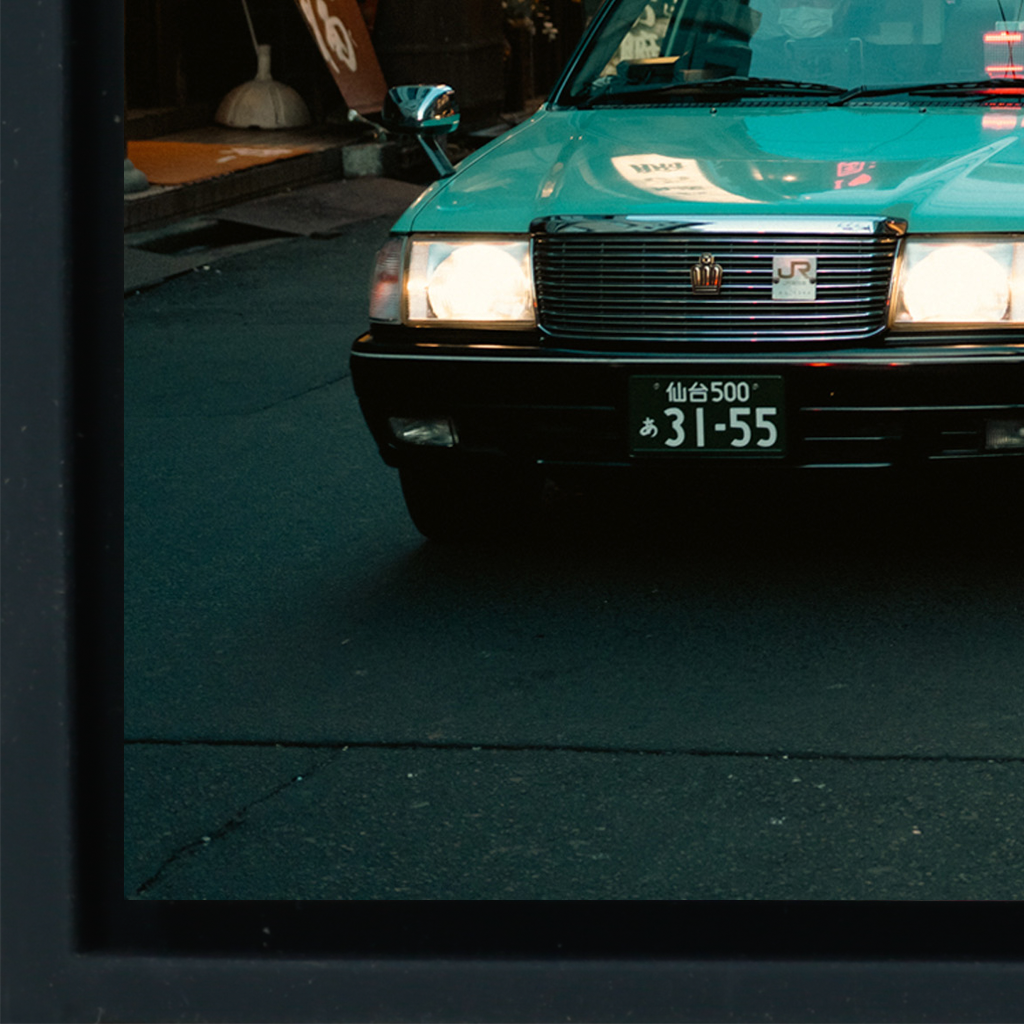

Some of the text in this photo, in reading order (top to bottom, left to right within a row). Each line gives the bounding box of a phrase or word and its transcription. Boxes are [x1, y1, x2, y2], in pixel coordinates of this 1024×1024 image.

[777, 261, 812, 279] JR
[639, 407, 778, 448] あ 31-55
